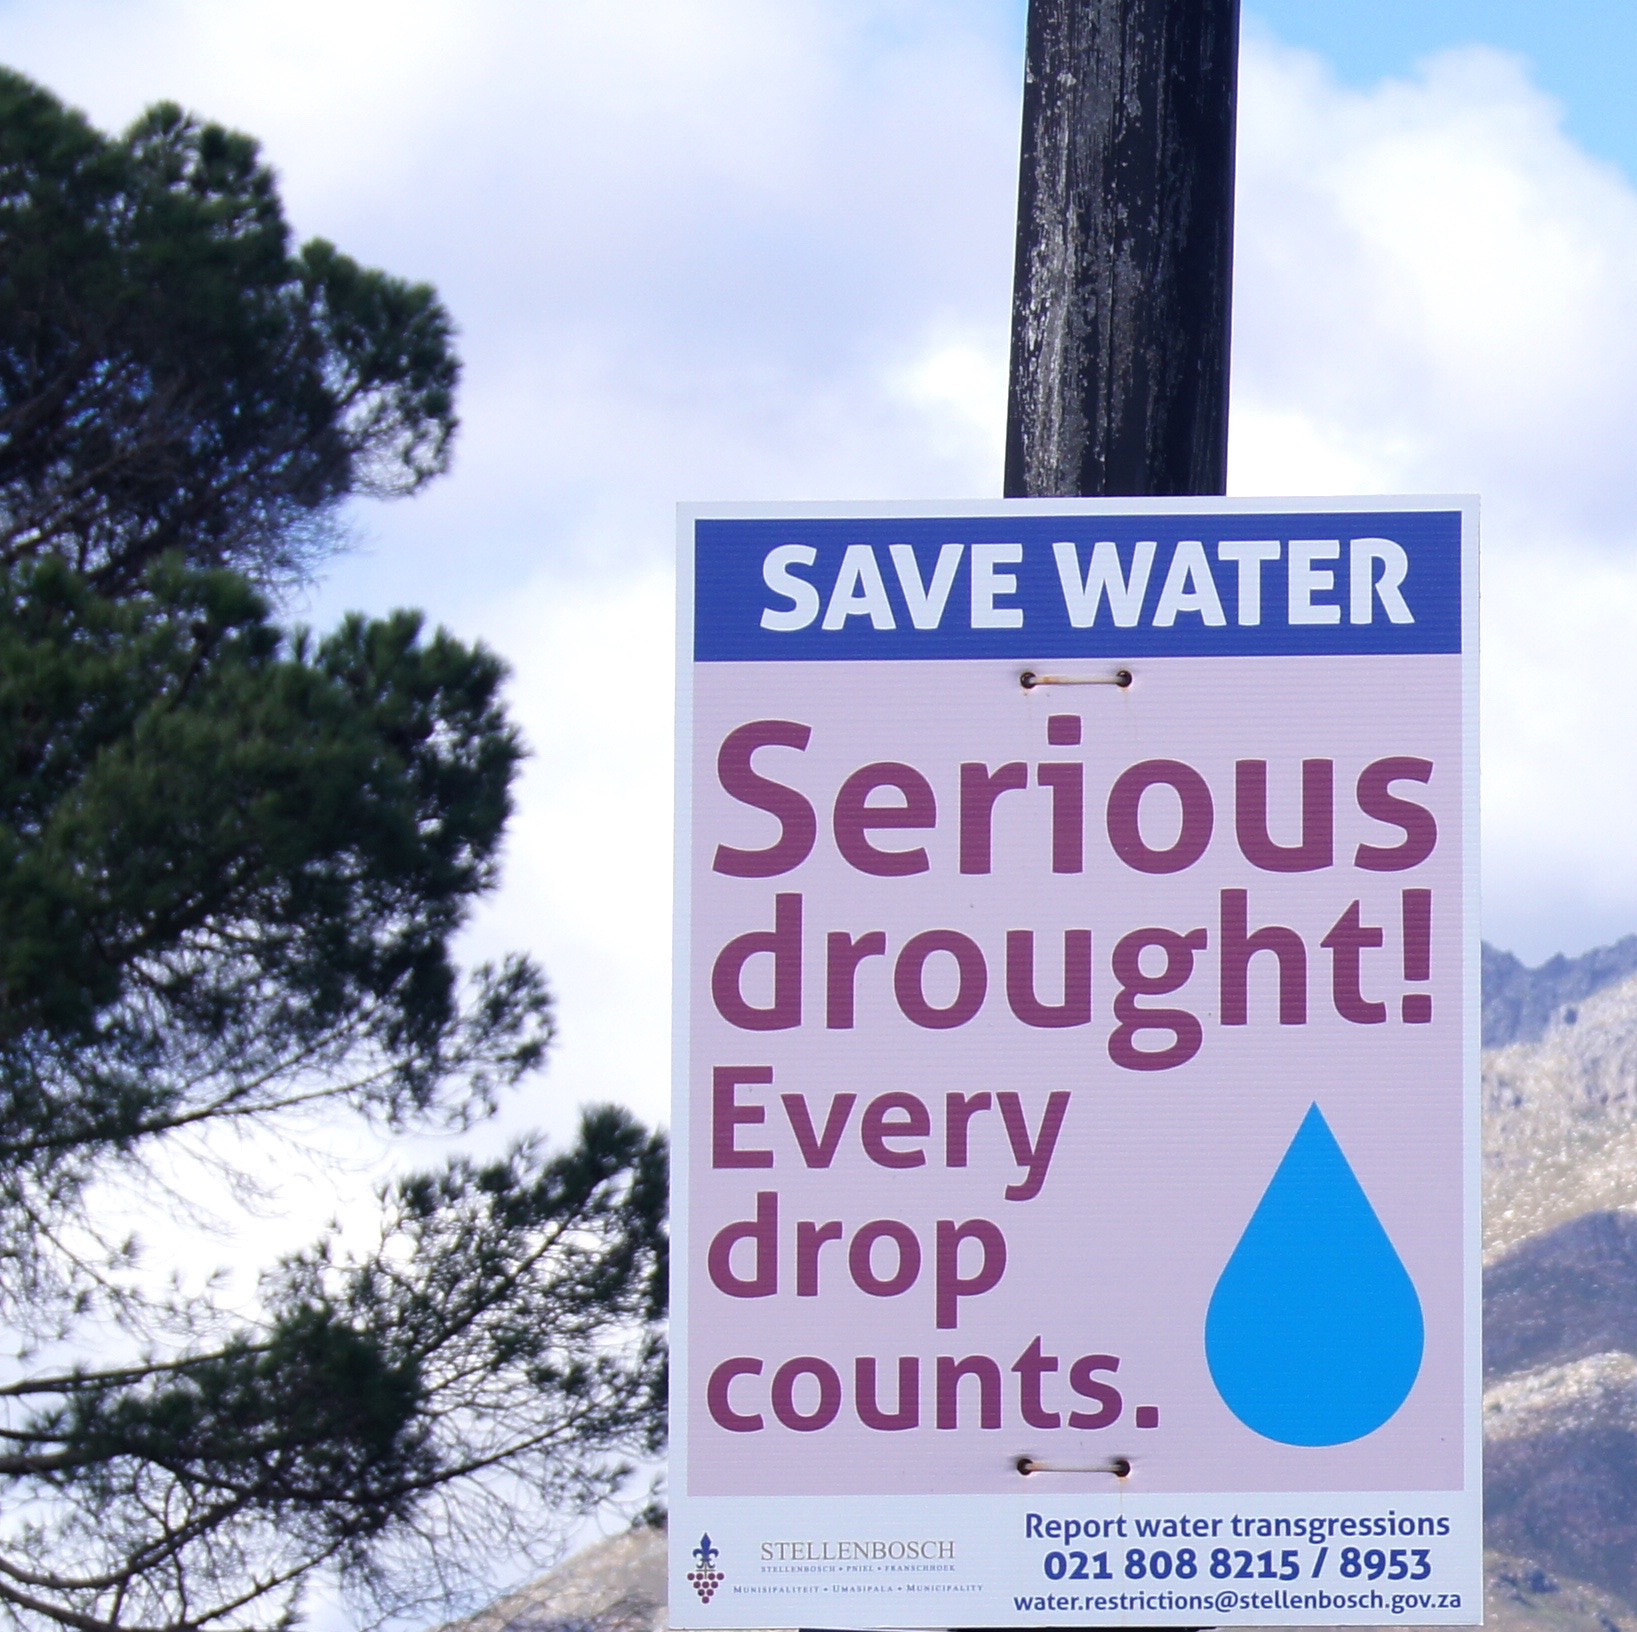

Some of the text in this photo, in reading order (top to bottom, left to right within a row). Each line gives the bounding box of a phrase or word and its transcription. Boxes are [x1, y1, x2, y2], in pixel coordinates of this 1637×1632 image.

[760, 538, 1415, 631] SAVE WATER
[712, 714, 1438, 878] Serious
[711, 888, 1432, 1071] drought!
[712, 1065, 1071, 1201] Every
[707, 1191, 1007, 1329] drop
[706, 1336, 1160, 1432] counts.
[761, 1541, 955, 1561] STELLENBOSCH
[1025, 1511, 1449, 1545] Report water transgressions
[1044, 1547, 1431, 1581] 021 808 8215 / 8953
[1014, 1590, 1461, 1613] water.restrictions@stellenbosch.gov.za
